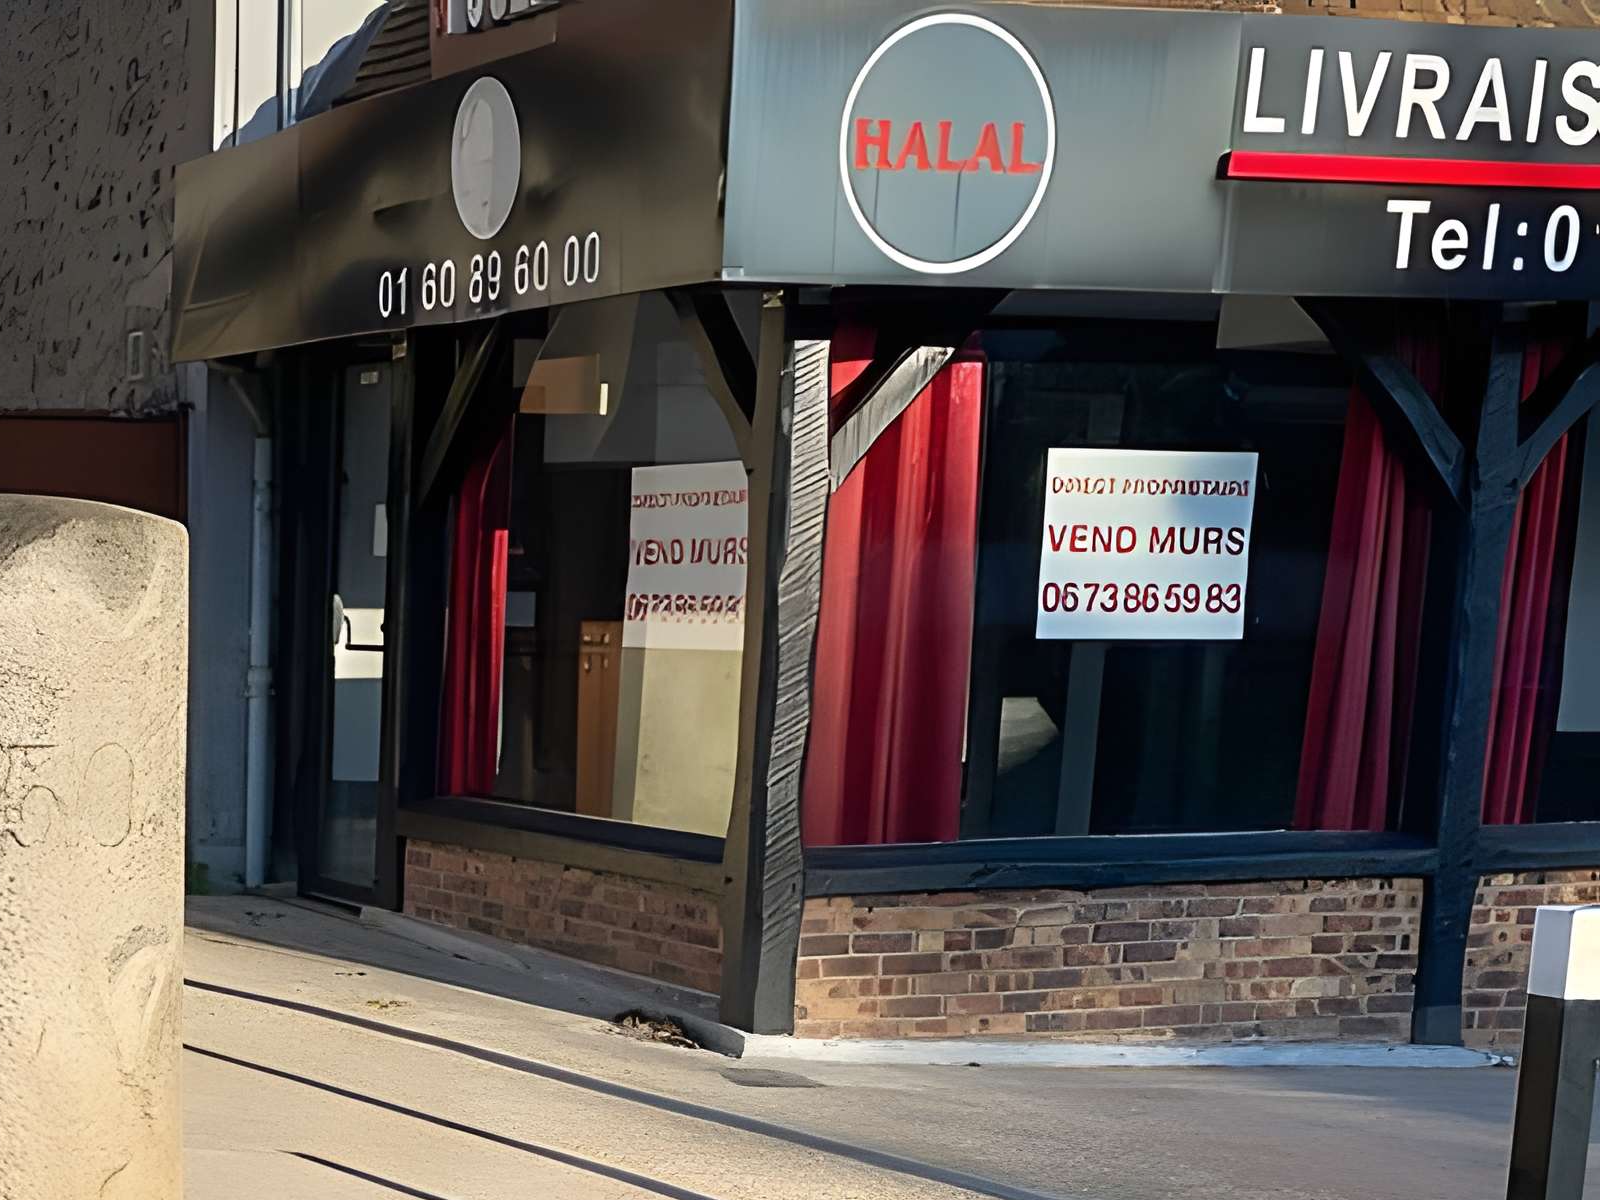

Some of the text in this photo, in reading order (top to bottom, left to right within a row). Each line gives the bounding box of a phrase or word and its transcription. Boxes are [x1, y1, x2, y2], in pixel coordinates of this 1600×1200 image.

[1243, 47, 1600, 146] LIVRAIS
[855, 118, 1043, 174] HALAL
[1386, 199, 1600, 273] Tel:0
[378, 231, 600, 318] 01 60 89 60 00
[1048, 524, 1247, 556] VEND MURS
